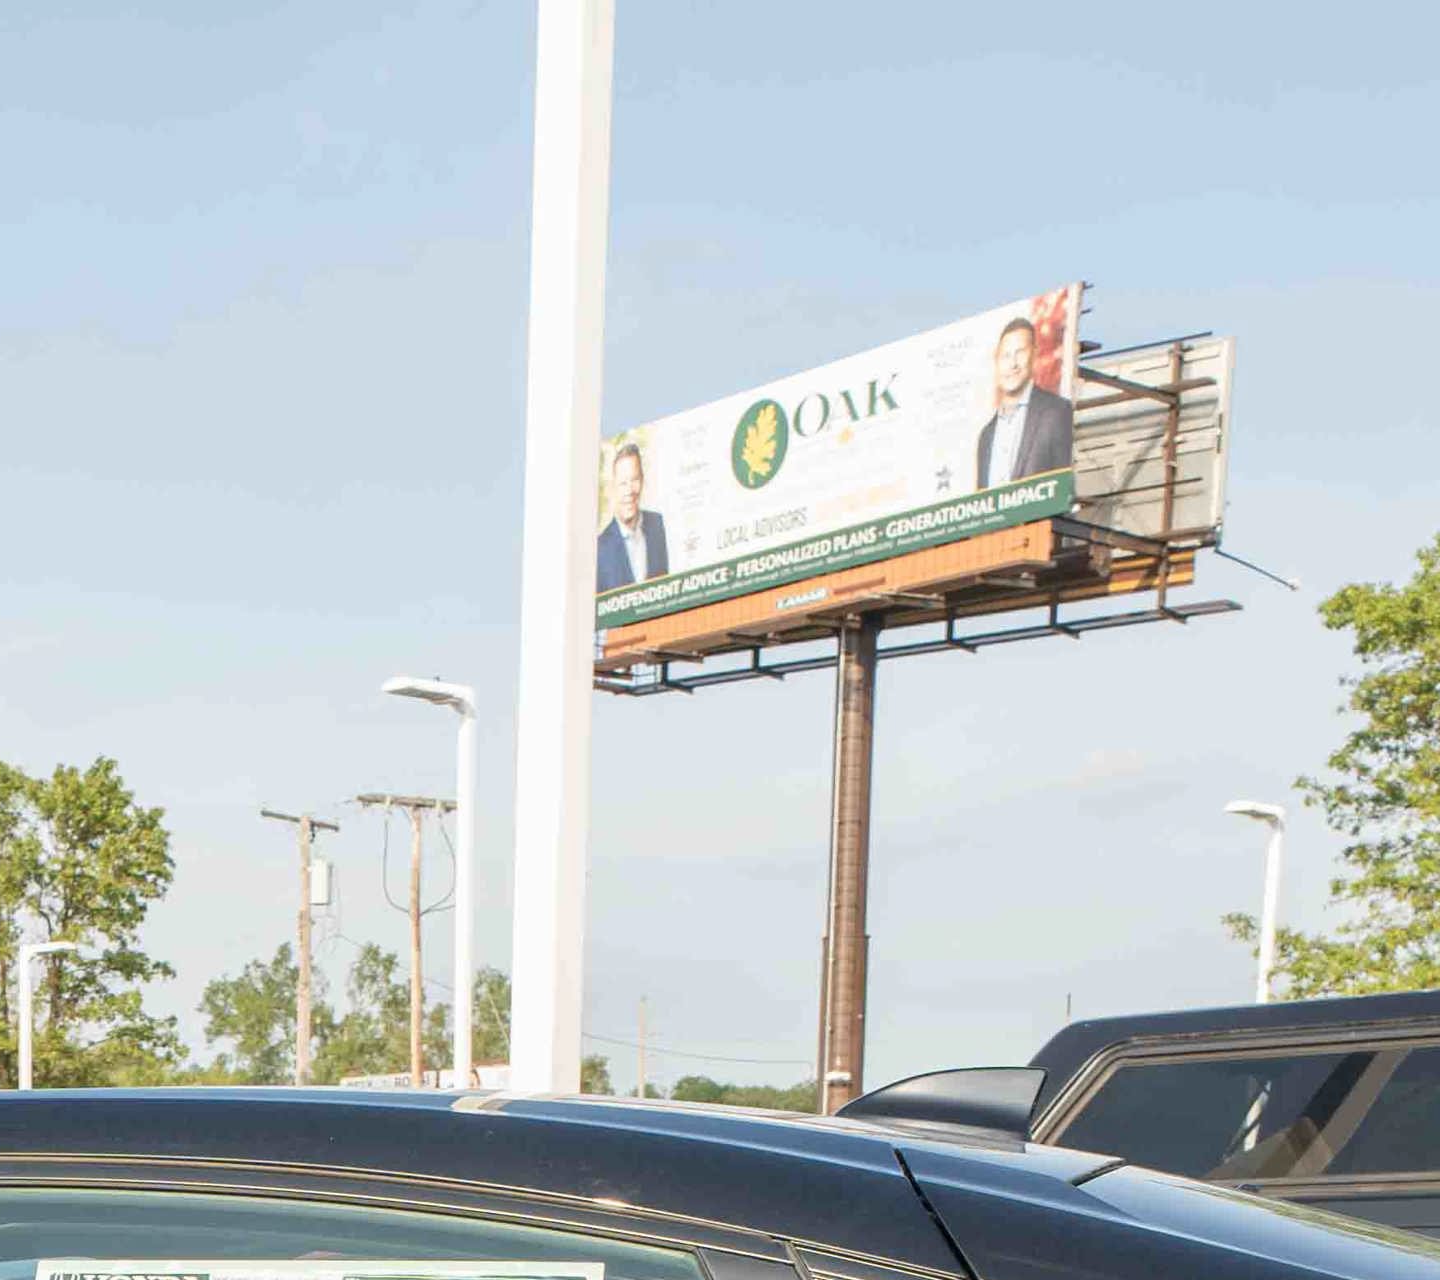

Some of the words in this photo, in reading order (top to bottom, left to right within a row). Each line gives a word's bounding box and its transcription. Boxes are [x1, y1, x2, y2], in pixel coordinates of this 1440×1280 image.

[793, 371, 901, 438] OAK
[598, 579, 682, 616] INDEPENDENT
[681, 566, 729, 594] ADVICE
[736, 539, 832, 578] PERSONALIZED
[834, 526, 879, 553] PLANS
[886, 496, 996, 538] GENERATIONAL
[999, 480, 1058, 509] IMPACT
[717, 525, 750, 550] LOCAL
[752, 507, 808, 540] ADVISORS
